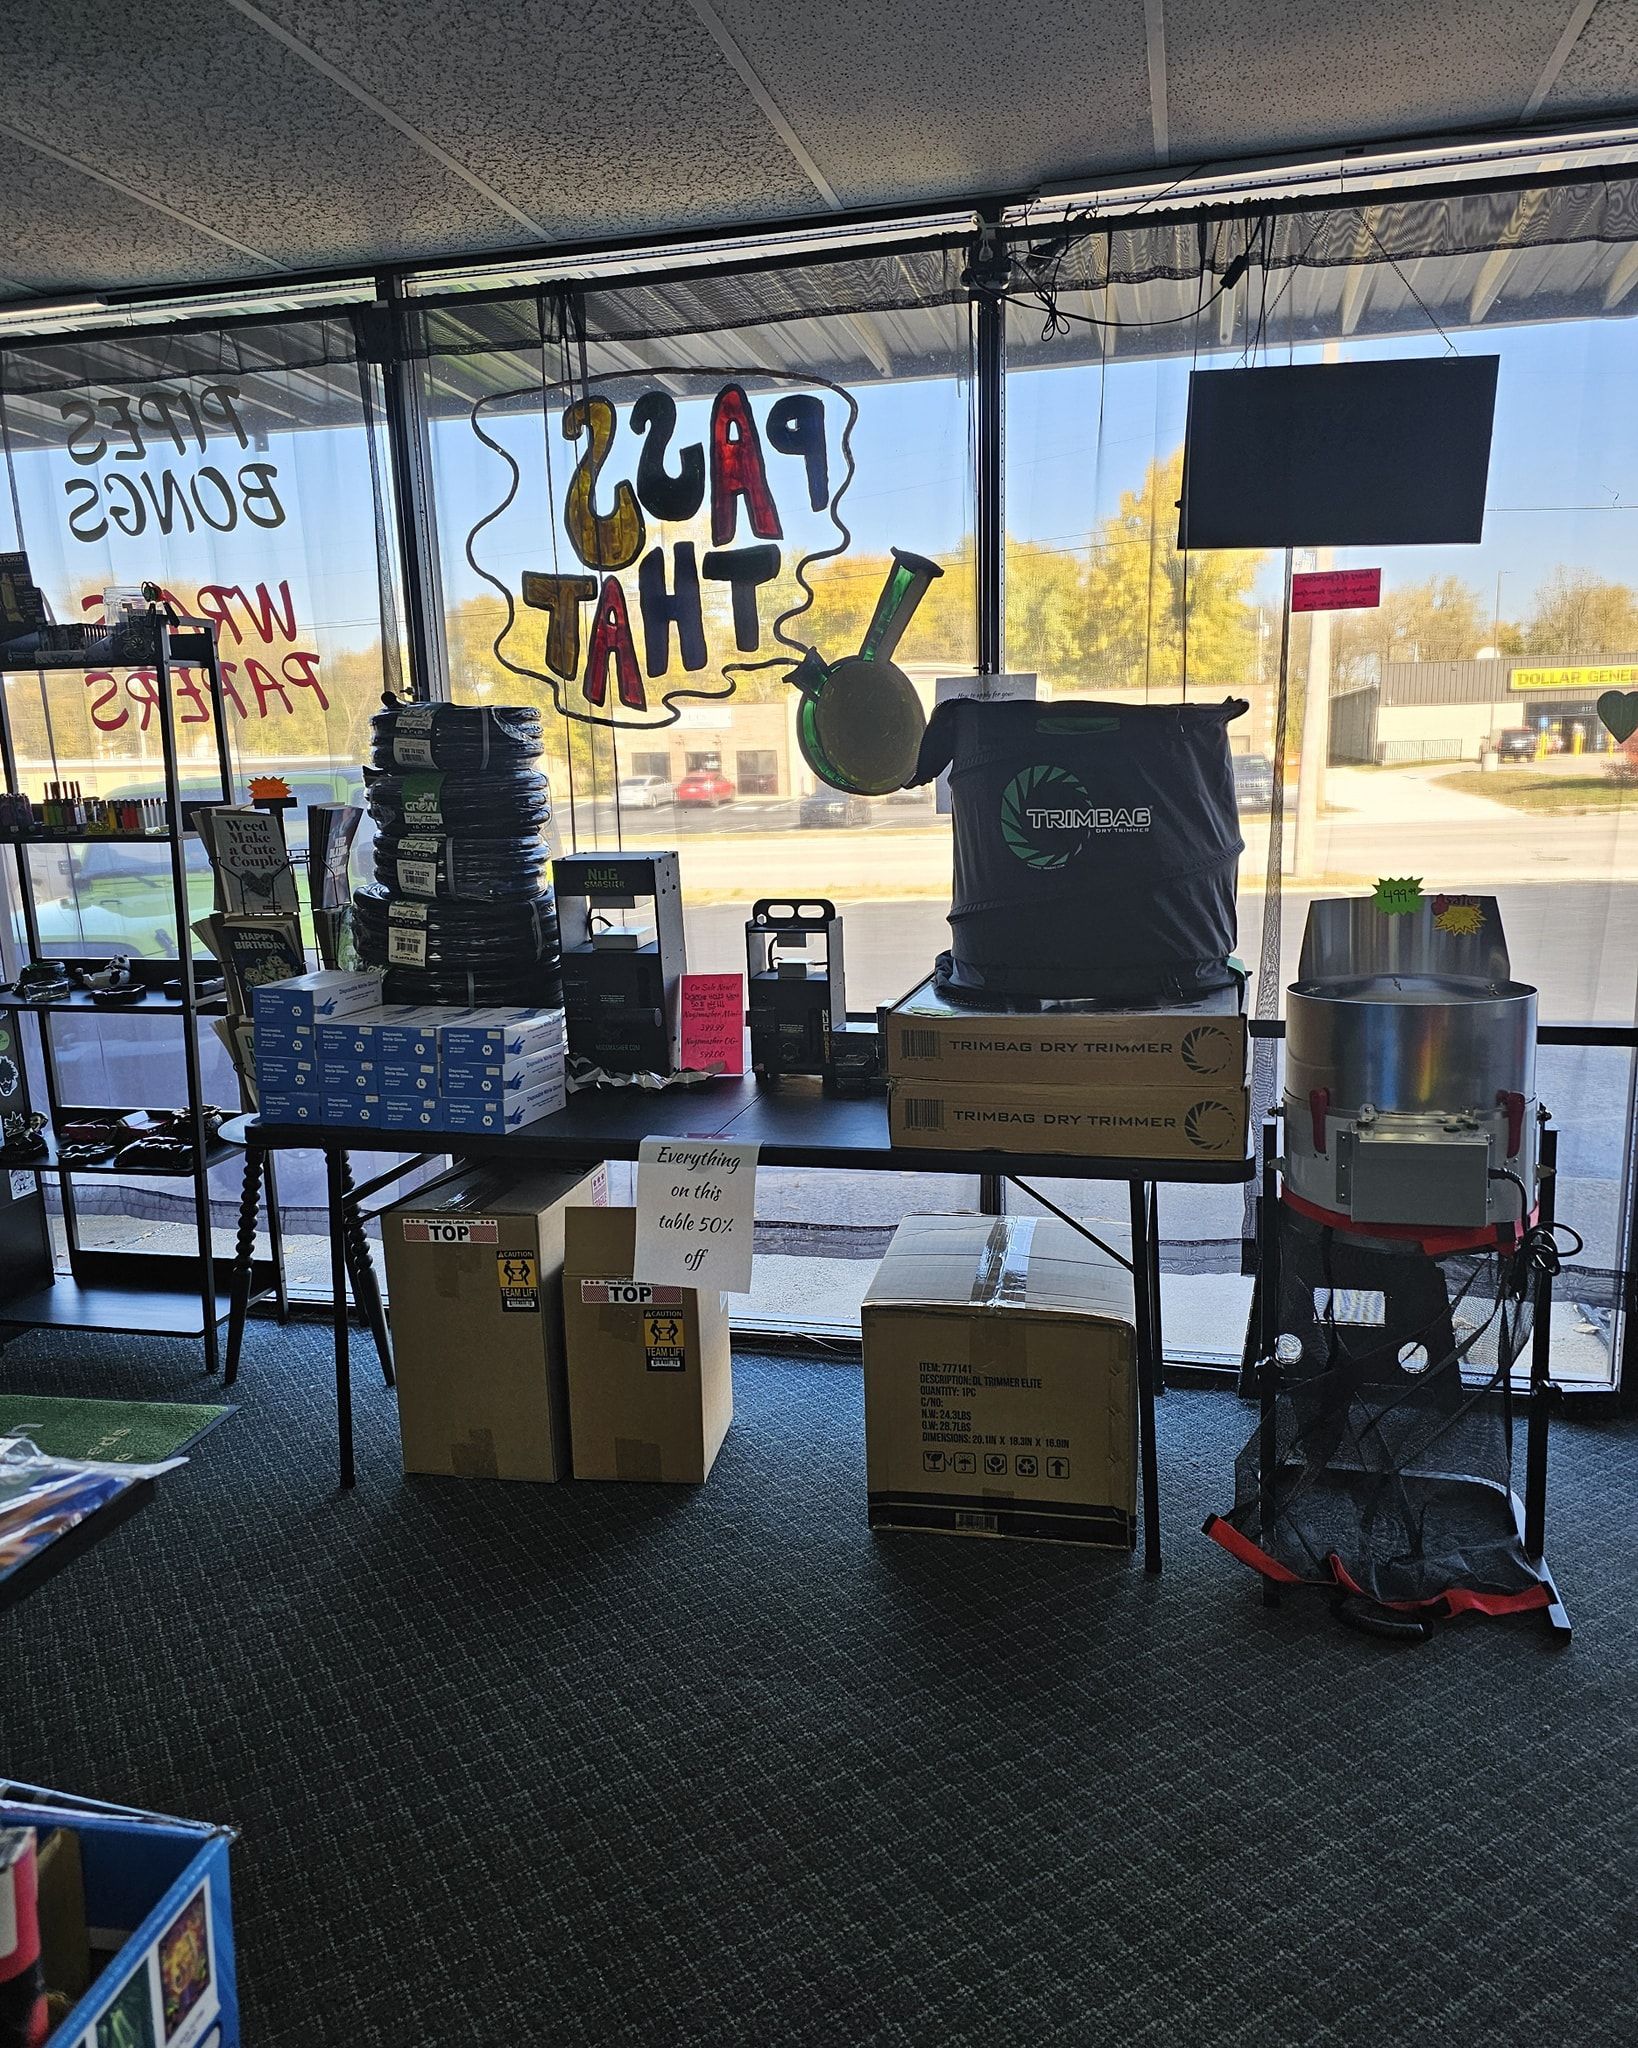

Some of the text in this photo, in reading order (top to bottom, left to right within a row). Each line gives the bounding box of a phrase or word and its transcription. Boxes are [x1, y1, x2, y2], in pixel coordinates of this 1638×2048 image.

[1516, 672, 1582, 685] DOLLAR
[1026, 808, 1151, 829] TRIMBAG
[225, 819, 268, 832] Weed
[228, 832, 272, 844] Make
[229, 844, 277, 856] a Cute
[238, 932, 274, 941] HAPPY
[234, 941, 286, 950] BIRTHDAY
[293, 1007, 301, 1015] XL
[950, 1040, 1172, 1054] TRIMBAG DRY TRIMMER
[954, 1110, 1176, 1128] TRIMBAG DRY TRIMMER
[657, 1147, 741, 1175] Everything
[671, 1181, 722, 1202] on this
[659, 1212, 734, 1234] table 50%
[429, 1226, 469, 1241] TOP
[684, 1249, 709, 1272] off
[502, 1288, 537, 1298] TEAM LIFT
[609, 1286, 652, 1302] TOP
[647, 1348, 684, 1356] TEAM LIFT
[919, 1362, 972, 1374] ITEM: 777141
[920, 1374, 971, 1386] DESCRIPTION:
[984, 1377, 1020, 1388] TRIMMER
[1021, 1378, 1042, 1389] ELITE
[920, 1386, 976, 1397] QUANTITY: 1PC
[921, 1398, 944, 1408] C/NO:
[922, 1409, 972, 1420] N.W: 24.3LBS
[922, 1421, 972, 1432] G.W: 28.7LBS
[923, 1432, 1041, 1447] DIMENSIONS: 20.1IN X 18.3IN X
